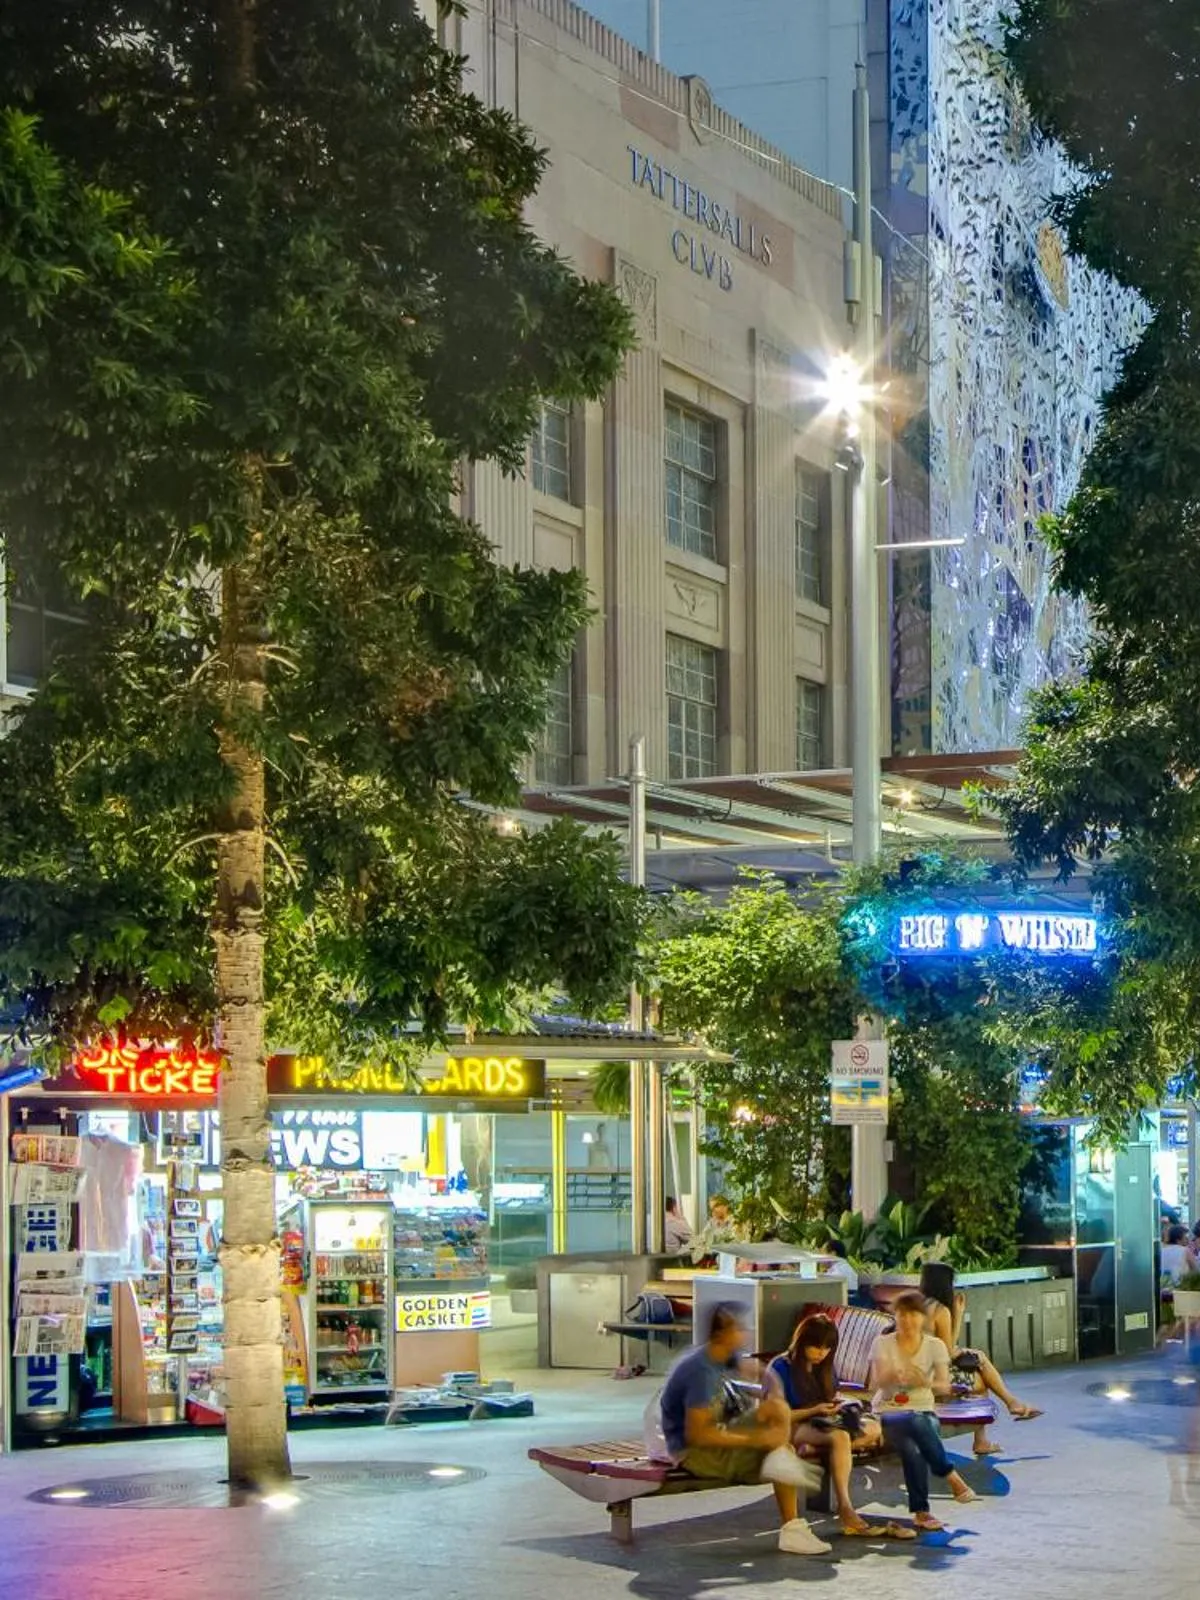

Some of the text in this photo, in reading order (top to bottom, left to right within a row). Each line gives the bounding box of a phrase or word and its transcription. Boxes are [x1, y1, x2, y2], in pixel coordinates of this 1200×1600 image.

[627, 144, 772, 266] TATTERSALLS
[900, 914, 948, 949] PIG
[422, 1057, 525, 1092] ARDS
[403, 1298, 468, 1312] GOLDEN
[404, 1313, 466, 1327] CASKET
